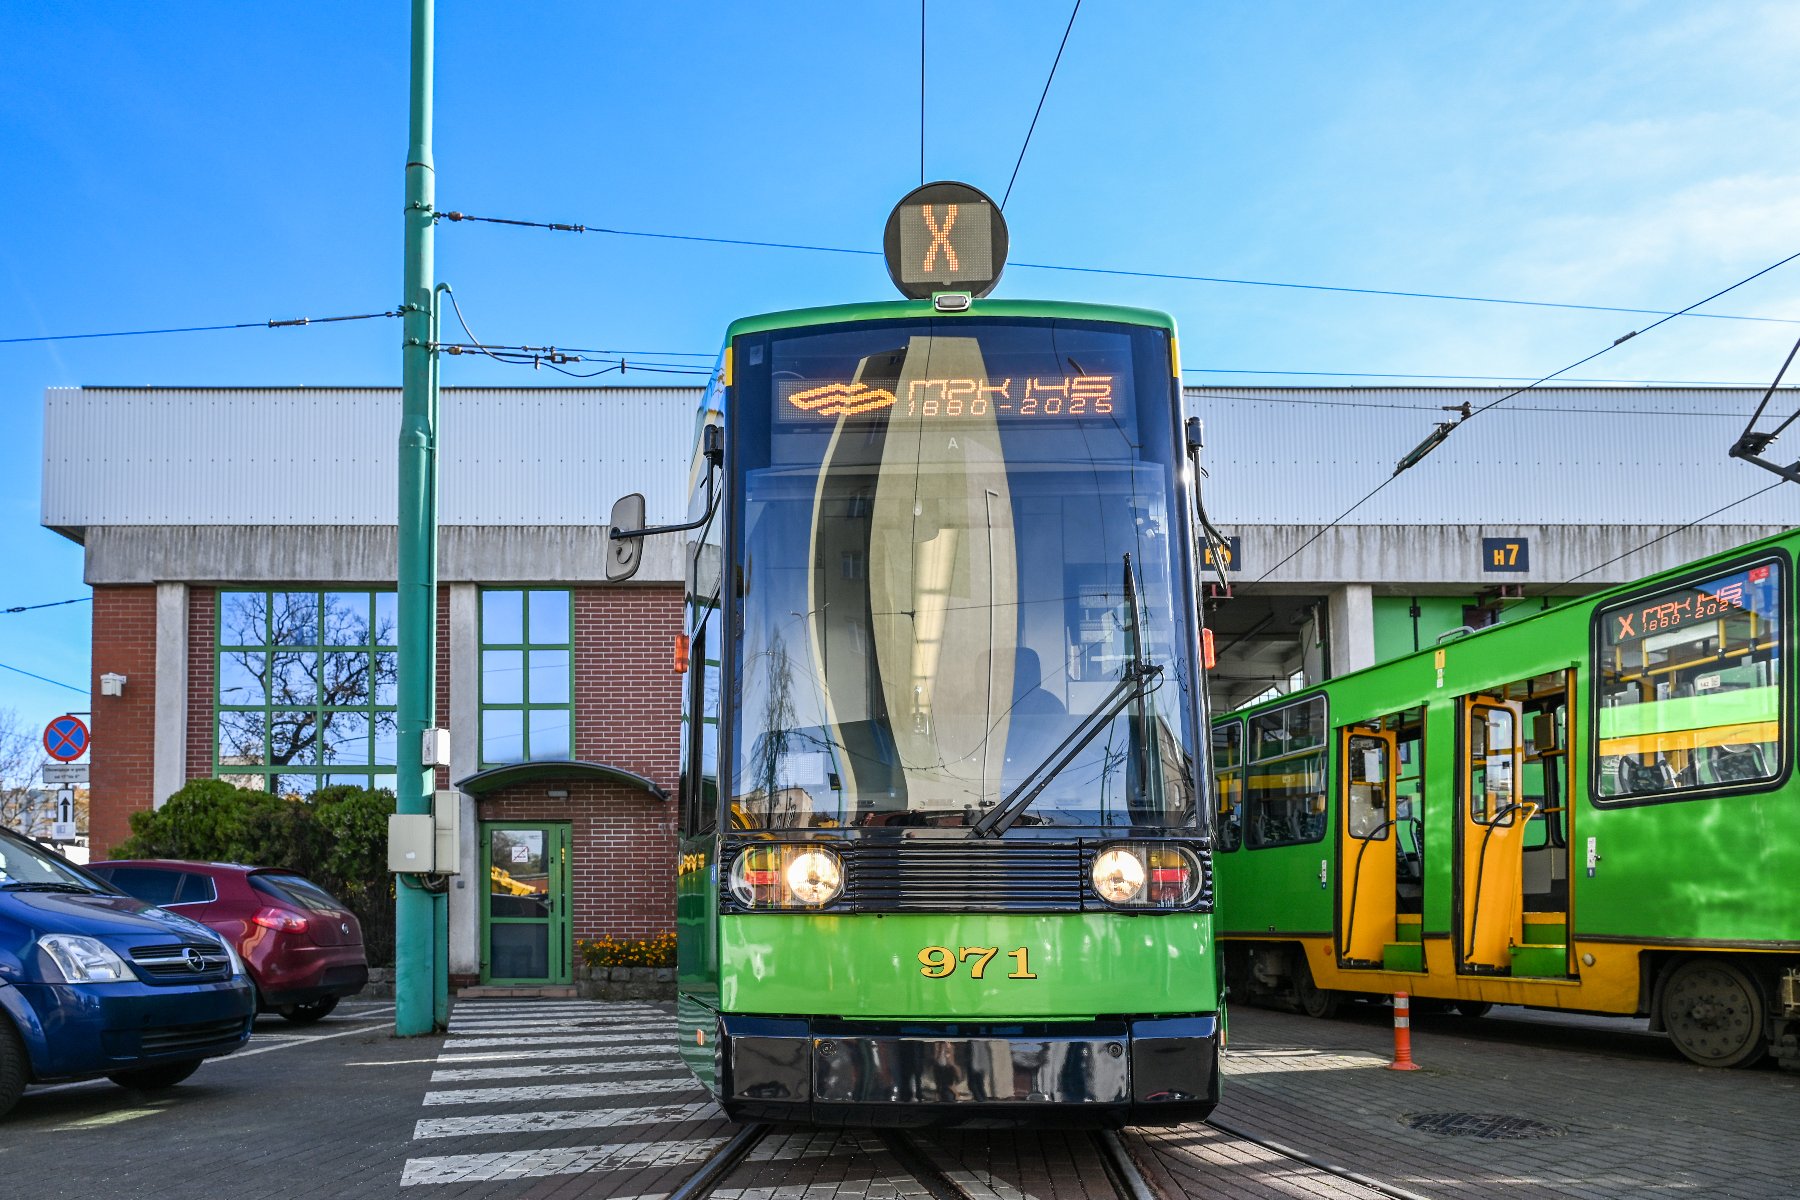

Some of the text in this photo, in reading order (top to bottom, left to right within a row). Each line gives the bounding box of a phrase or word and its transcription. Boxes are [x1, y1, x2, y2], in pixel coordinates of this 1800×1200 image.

[923, 204, 959, 272] X
[909, 376, 1113, 400] MPK 145
[948, 437, 958, 449] A
[1493, 544, 1520, 566] H7
[1642, 597, 1691, 624] MPK
[1618, 613, 1635, 640] X
[917, 945, 1038, 979] 971
